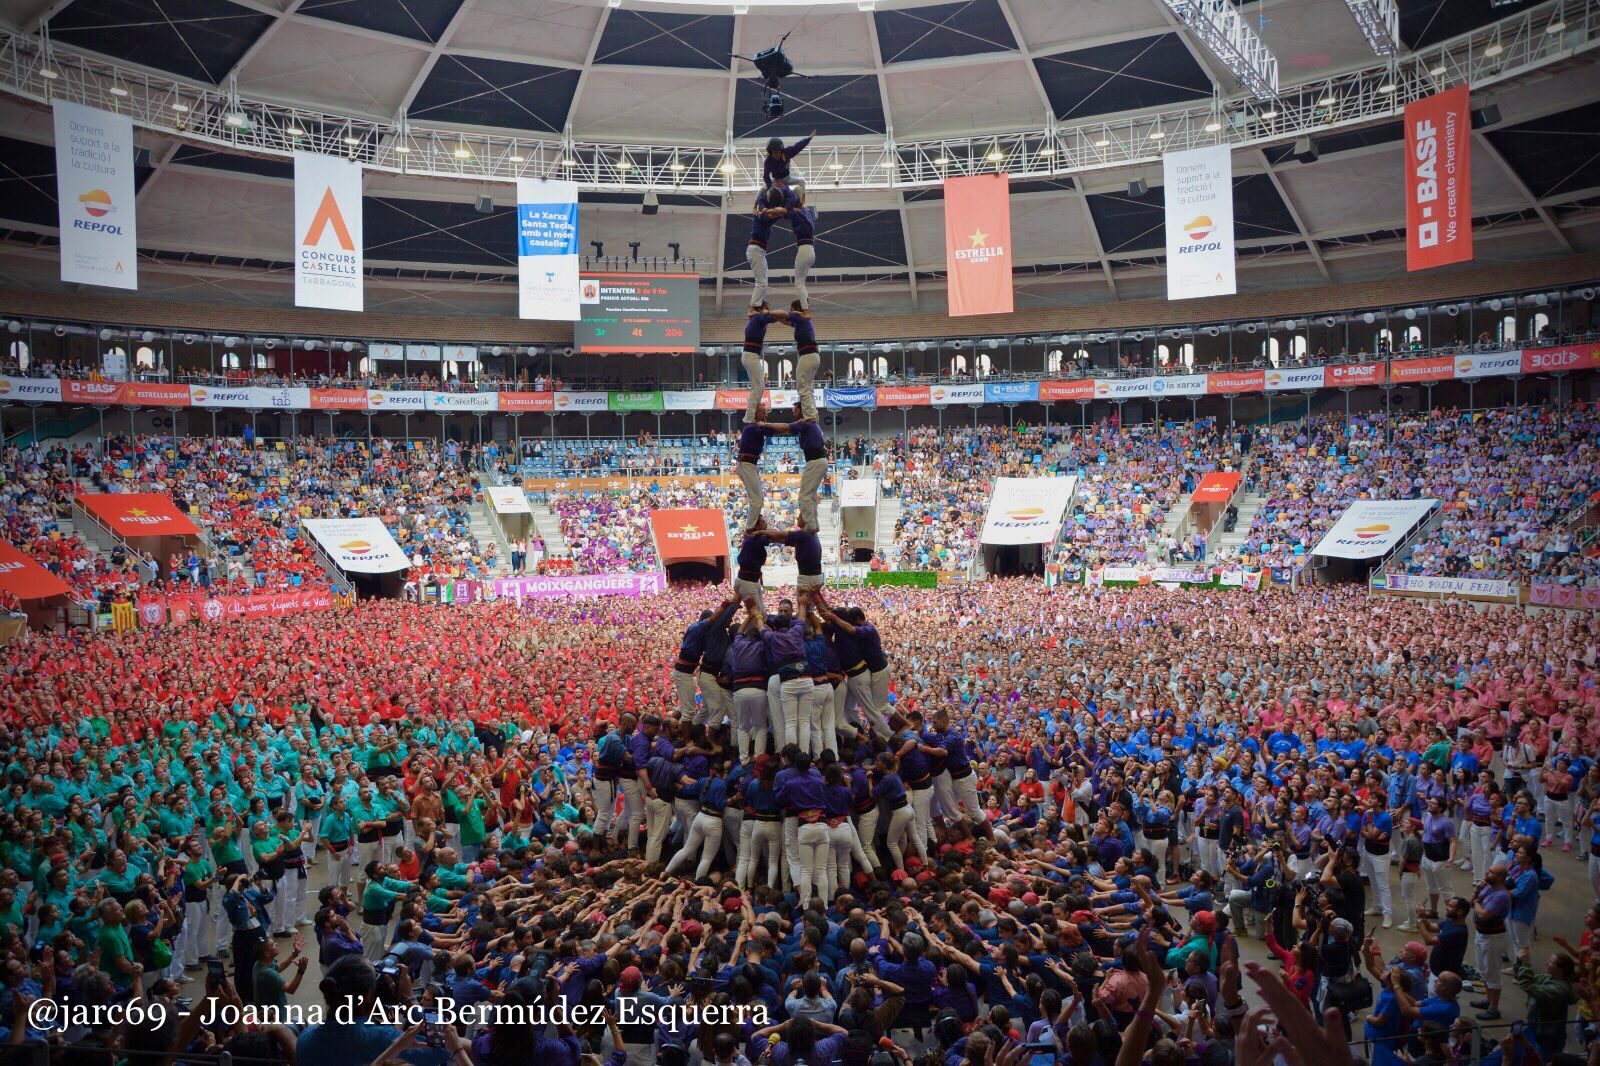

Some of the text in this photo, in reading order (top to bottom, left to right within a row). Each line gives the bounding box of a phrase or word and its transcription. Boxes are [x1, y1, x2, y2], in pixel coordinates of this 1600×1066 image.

[69, 121, 104, 136] Donem
[70, 134, 120, 152] suport a la
[71, 147, 107, 162] tradició
[71, 157, 116, 176] la cultura
[1416, 119, 1437, 204] BASF
[1176, 163, 1205, 174] Donem
[1176, 174, 1203, 186] suport
[1212, 171, 1220, 179] la
[1445, 111, 1457, 243] We create chemistry
[1177, 184, 1208, 195] tradició
[1178, 193, 1216, 205] la cultura
[529, 211, 568, 221] La Xarxa
[73, 219, 123, 235] REPSOL
[521, 220, 548, 229] Santa
[521, 229, 574, 239] amb el món
[529, 239, 569, 248] casteller
[1179, 242, 1222, 255] REPSOL
[301, 250, 356, 264] CONCURS
[955, 246, 1004, 260] ESTRELLA
[301, 261, 356, 274] CASTELLS
[303, 277, 357, 289] TARRAGONA
[631, 328, 643, 337] 4t
[1479, 359, 1520, 369] REPSOL
[1531, 352, 1569, 367] 3cat
[1347, 365, 1376, 377] BASF
[1400, 367, 1431, 376] ESTRELLA
[1216, 379, 1243, 387] ESTRELLA
[1287, 374, 1323, 383] REPSOL
[18, 385, 60, 394] REPSOL
[87, 383, 116, 393] BASF
[1115, 383, 1149, 392] REPSOL
[1176, 381, 1201, 389] xarxa
[137, 391, 169, 399] ESTRELLA
[213, 393, 250, 401] REPSOL
[630, 393, 654, 401] BASF
[447, 396, 489, 406] CaixaBank
[993, 520, 1050, 528] REPSOL
[667, 531, 715, 539] ESTRELLA
[341, 553, 391, 561] REPSOL
[525, 578, 634, 593] MOIXIGANGUERS
[1409, 580, 1424, 588] HO
[1428, 579, 1464, 590] PODEM
[301, 599, 311, 607] de
[313, 597, 330, 607] Valls
